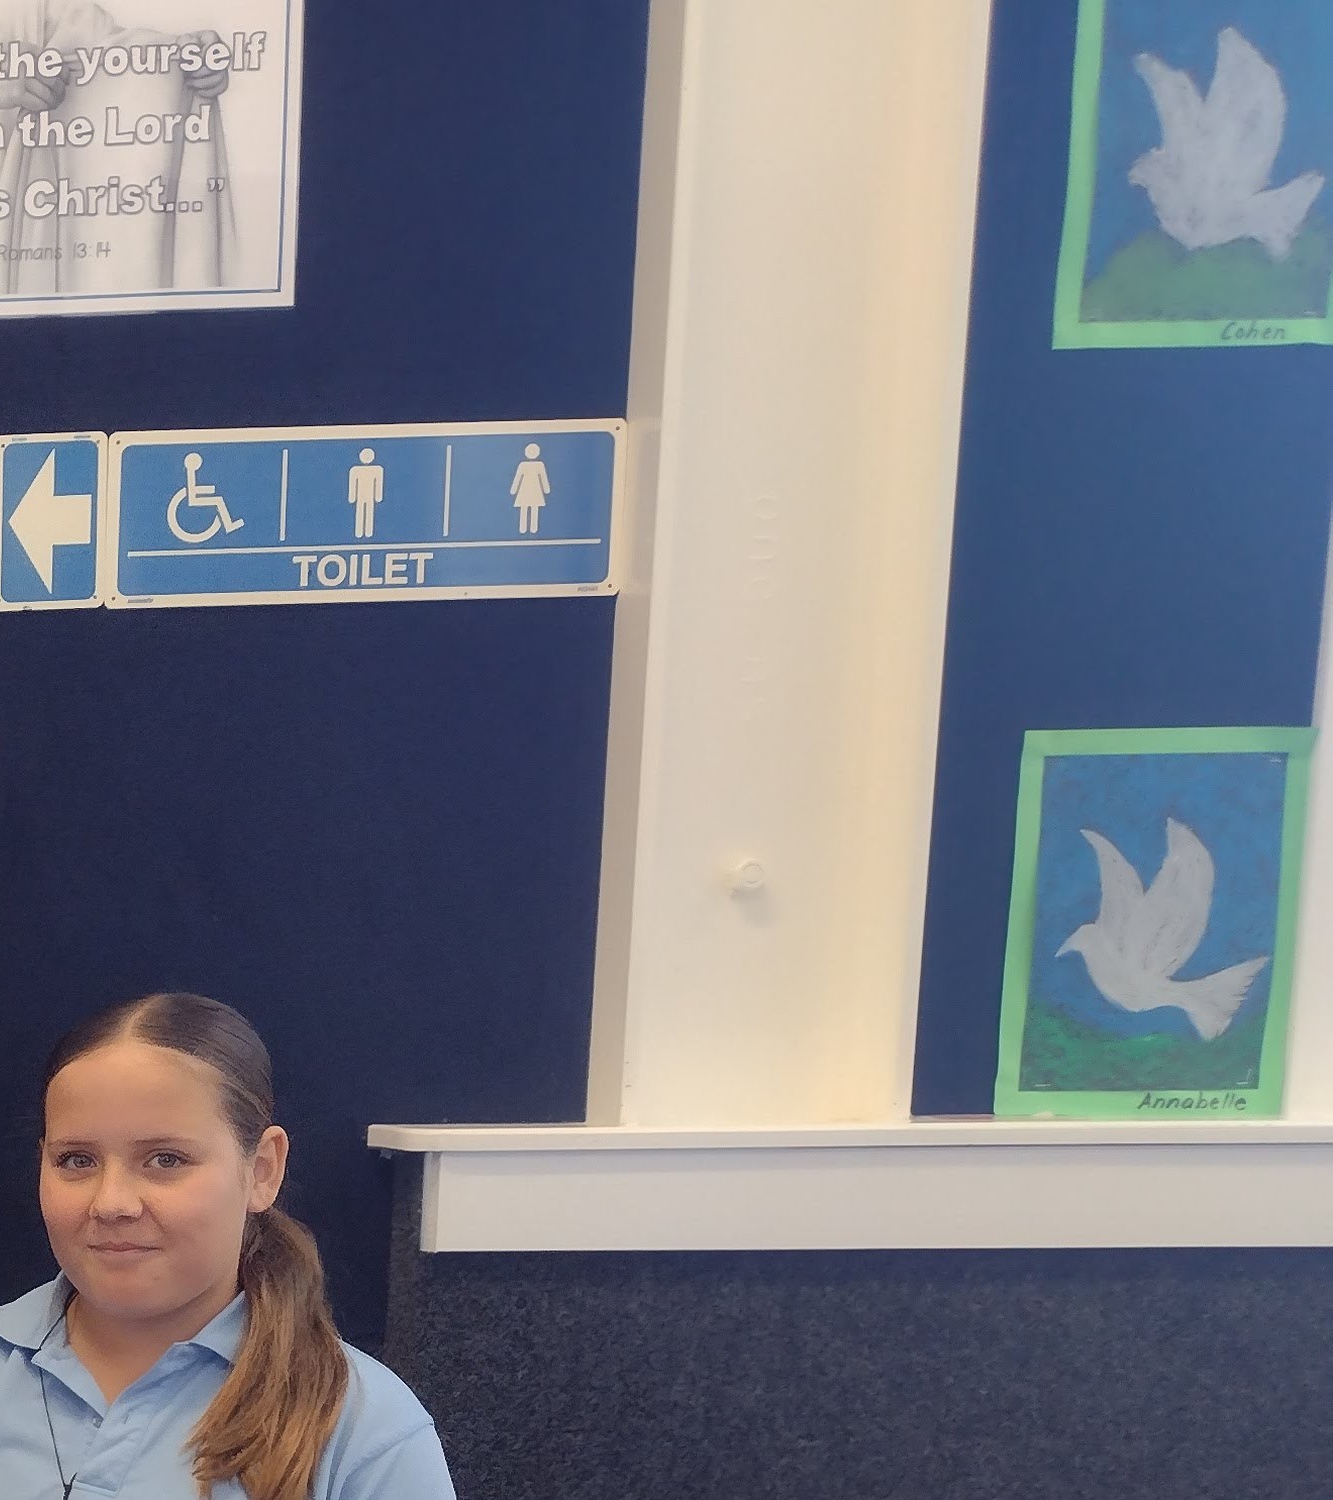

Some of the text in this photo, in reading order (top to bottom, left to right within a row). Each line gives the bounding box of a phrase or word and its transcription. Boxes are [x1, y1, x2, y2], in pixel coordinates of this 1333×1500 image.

[75, 31, 267, 86] yourself
[18, 108, 95, 148] the
[104, 105, 211, 146] Lord
[1220, 321, 1287, 342] Cohen
[292, 551, 434, 588] TOILET
[1137, 1092, 1247, 1112] Annabelle
